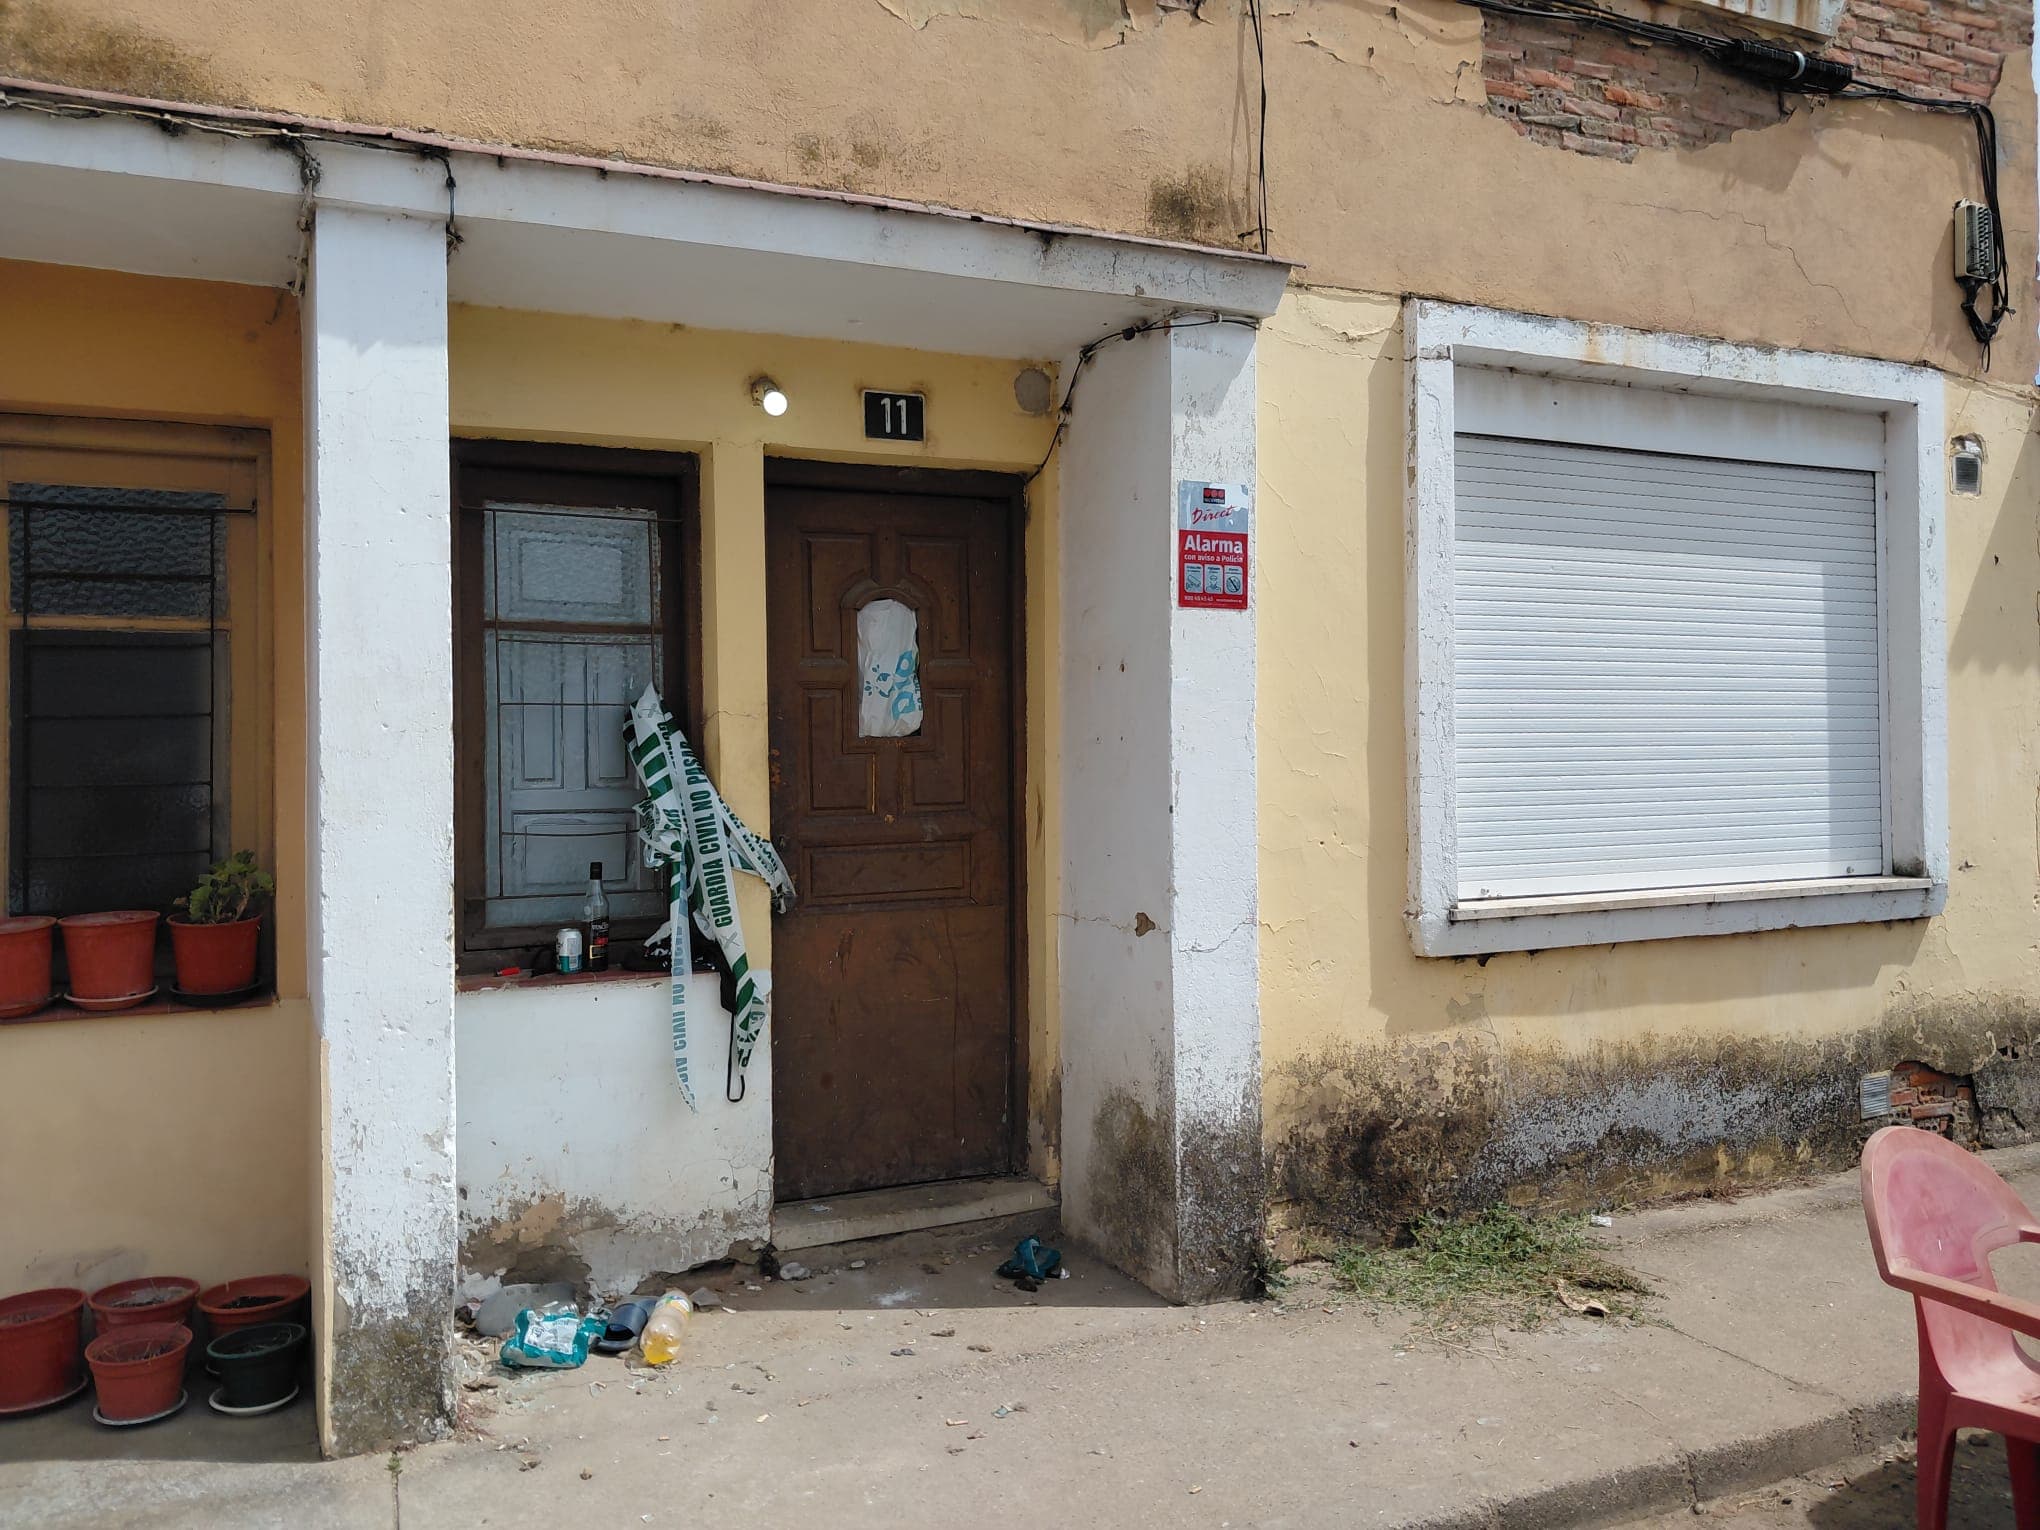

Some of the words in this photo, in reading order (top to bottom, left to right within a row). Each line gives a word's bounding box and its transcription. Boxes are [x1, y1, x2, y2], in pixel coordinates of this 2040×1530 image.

[880, 397, 907, 434] 11
[1184, 534, 1243, 554] Alarma
[689, 789, 713, 814] NO
[694, 812, 721, 855] CIVIL
[702, 857, 734, 928] GUARDIA
